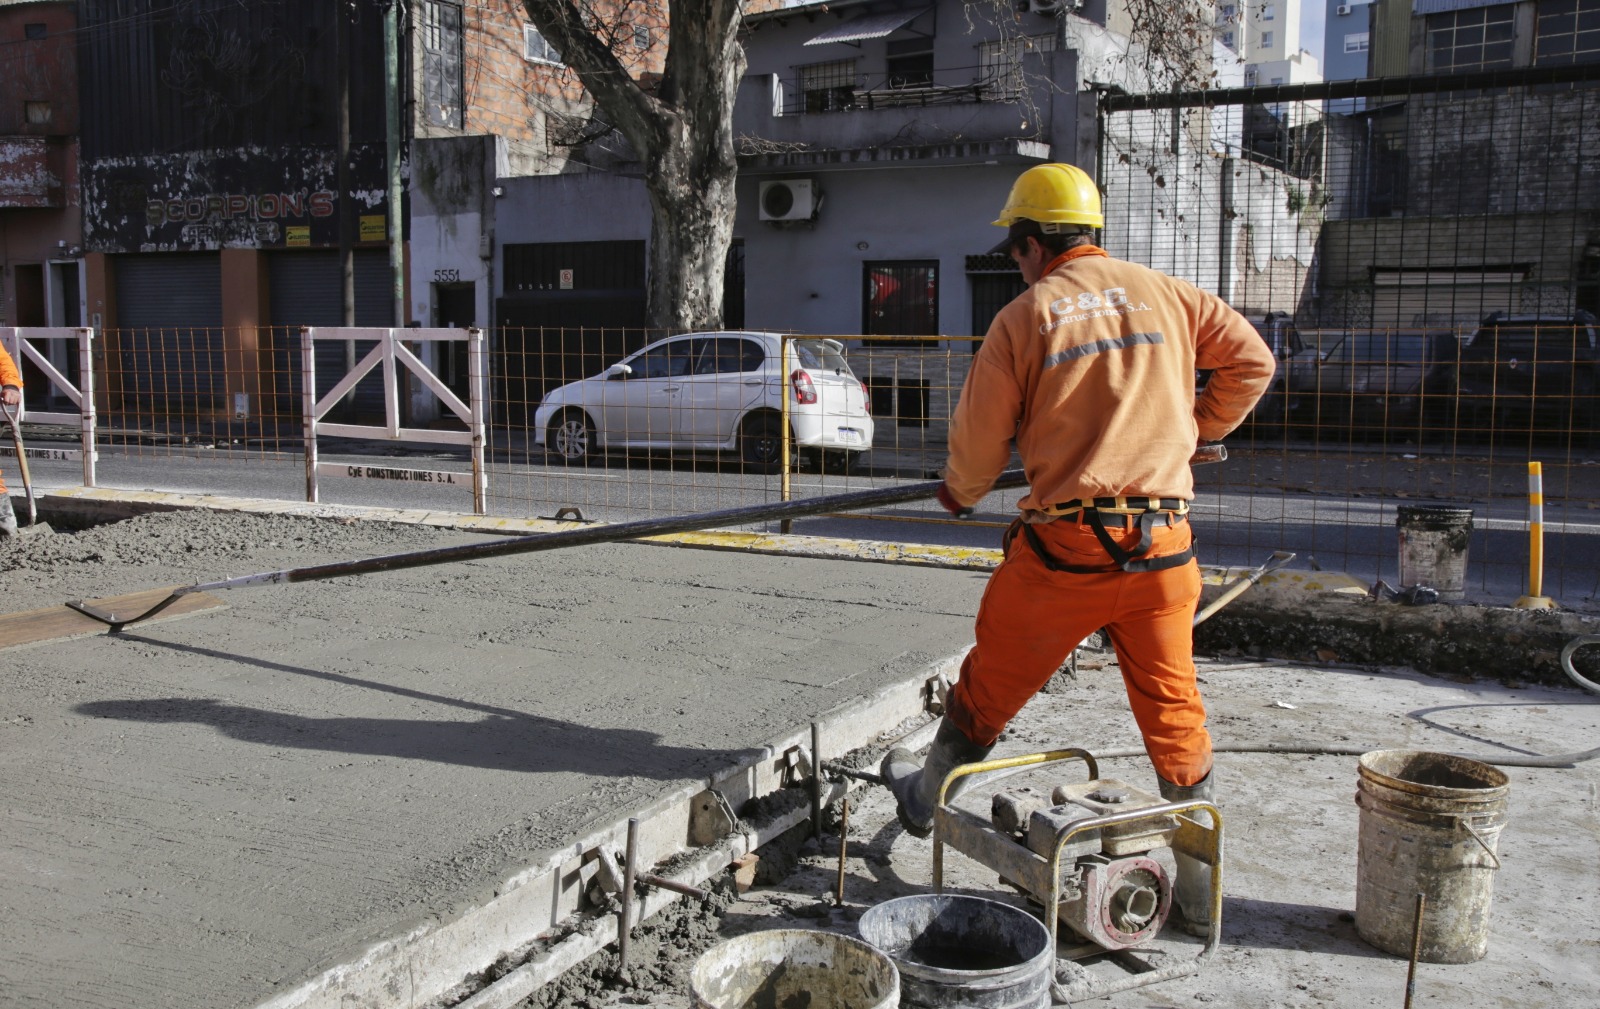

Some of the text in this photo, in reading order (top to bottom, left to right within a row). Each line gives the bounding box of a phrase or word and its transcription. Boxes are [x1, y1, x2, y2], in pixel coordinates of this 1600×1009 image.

[146, 188, 334, 225] SCORPION'S
[434, 269, 460, 282] 5551
[1126, 301, 1152, 314] S.A.
[0, 448, 50, 459] ONSTCIONES
[348, 466, 362, 478] CyE
[366, 467, 433, 482] CONSTRUCCIONES
